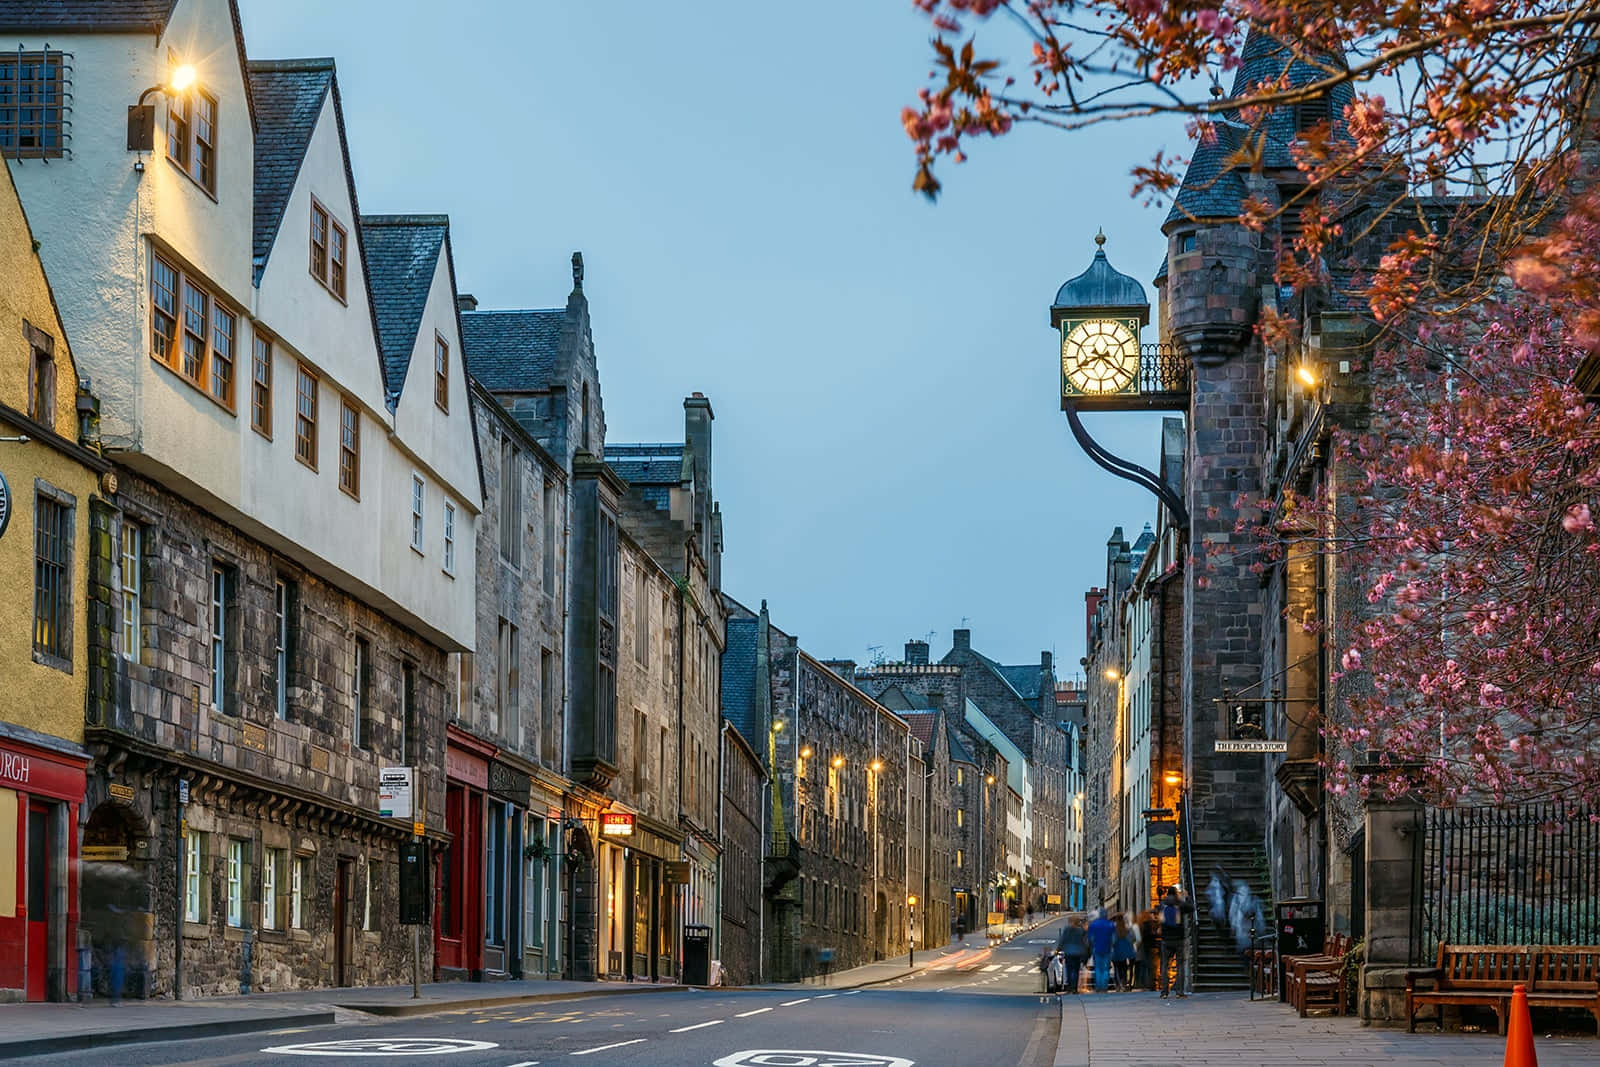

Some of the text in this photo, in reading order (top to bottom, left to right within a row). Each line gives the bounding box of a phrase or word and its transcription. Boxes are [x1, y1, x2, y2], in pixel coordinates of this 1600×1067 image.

[1128, 320, 1136, 330] 8
[1065, 382, 1136, 394] 8 4
